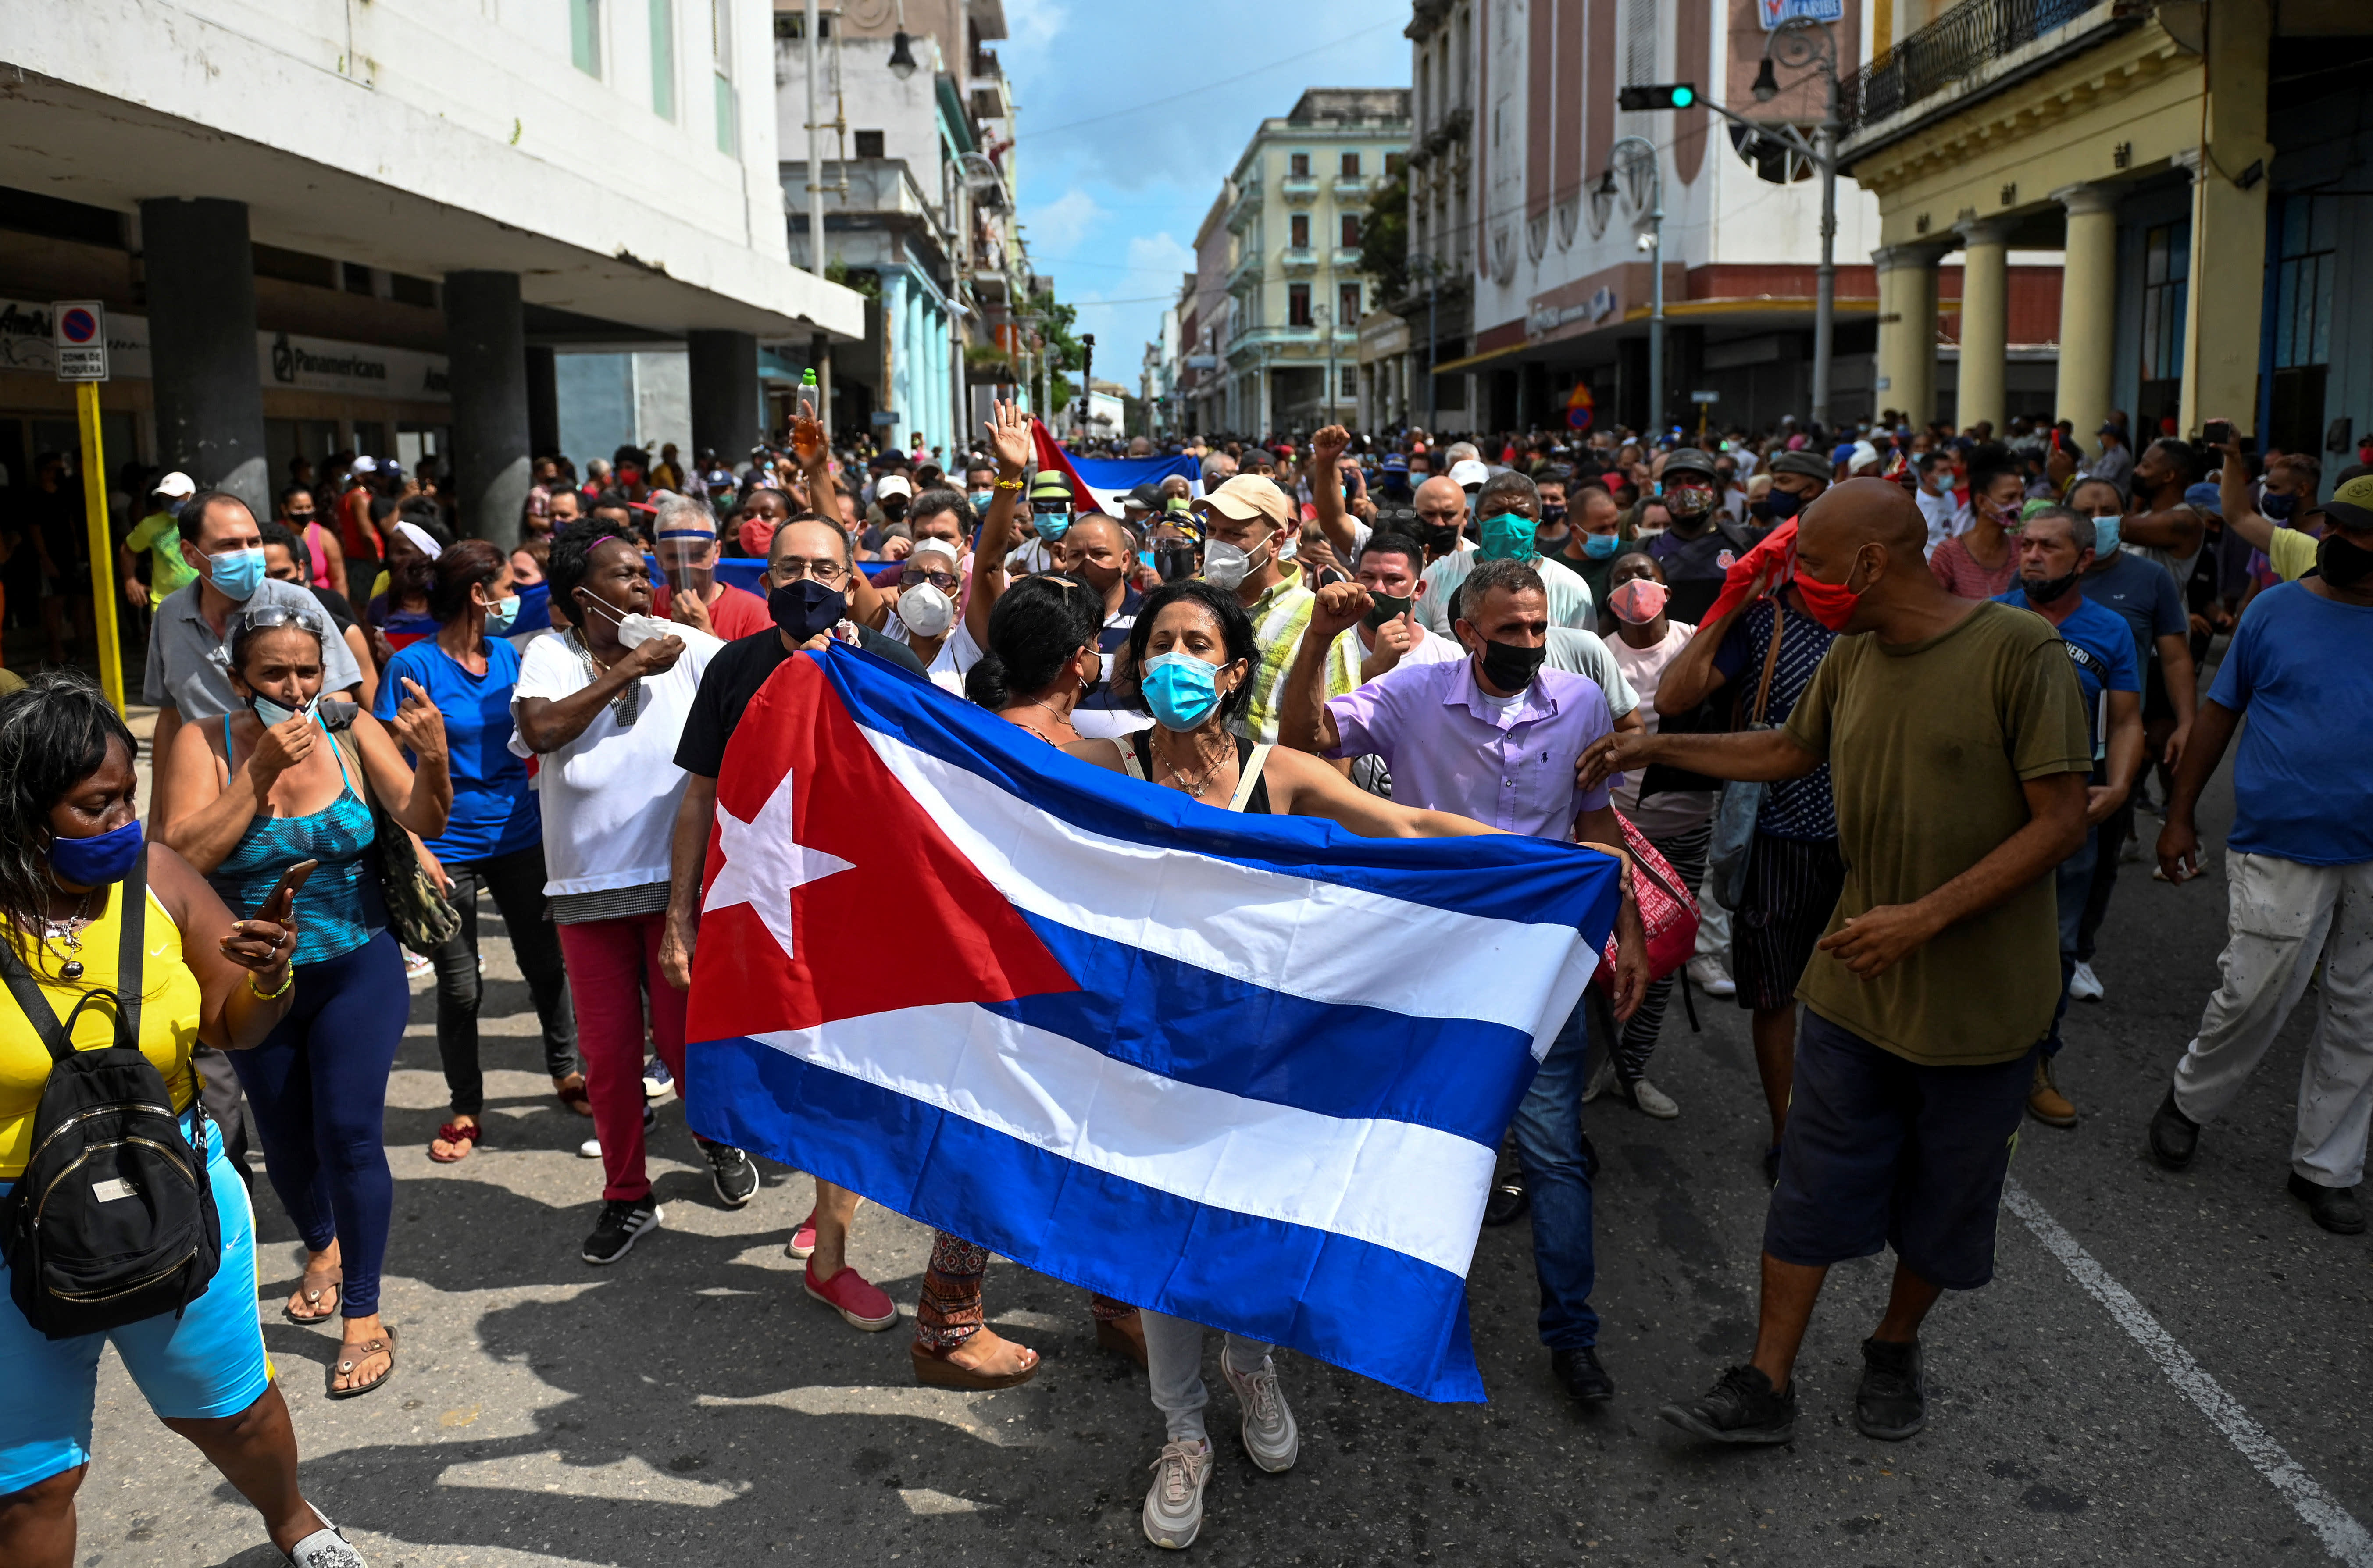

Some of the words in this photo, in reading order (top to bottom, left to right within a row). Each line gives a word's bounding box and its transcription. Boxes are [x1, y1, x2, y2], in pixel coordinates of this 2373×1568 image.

[63, 365, 101, 373] PIQUERA
[296, 348, 386, 381] Panamericana
[1650, 897, 1674, 920] THABA
